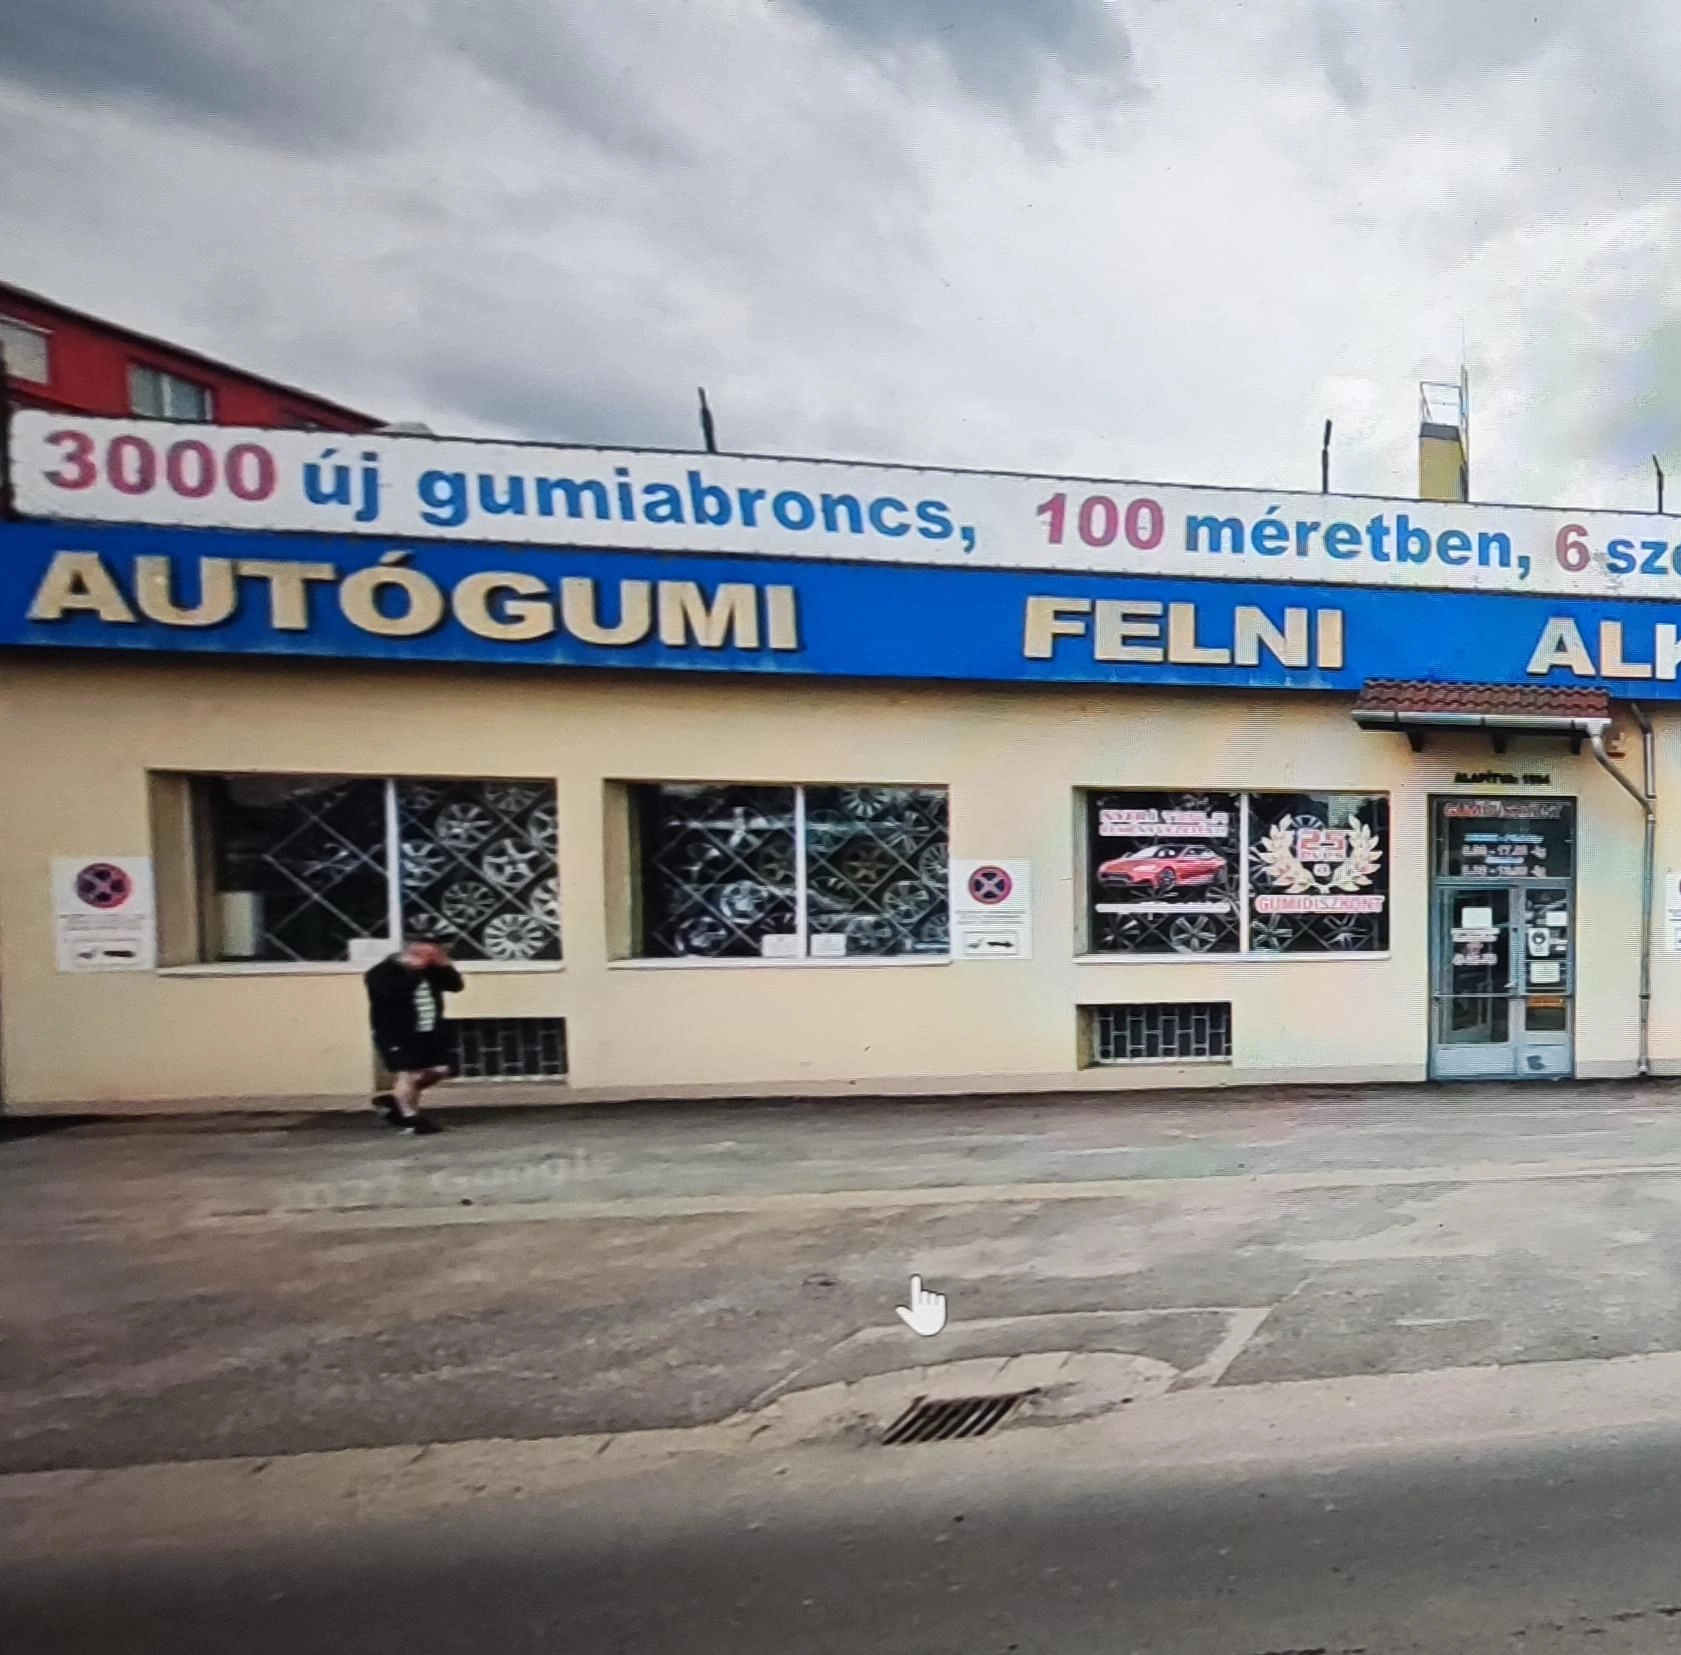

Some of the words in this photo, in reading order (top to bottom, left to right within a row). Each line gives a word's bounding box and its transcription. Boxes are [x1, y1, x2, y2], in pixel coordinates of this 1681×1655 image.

[43, 429, 278, 500] 3000
[303, 448, 381, 524] új
[417, 467, 977, 553] gumiabroncs,
[1035, 492, 1164, 551] 100
[1184, 506, 1532, 580] méretben,
[1555, 524, 1589, 573] 6
[28, 549, 801, 651] AUTÓGUMI
[1022, 596, 1345, 671] FELNI
[1300, 830, 1344, 850] 25
